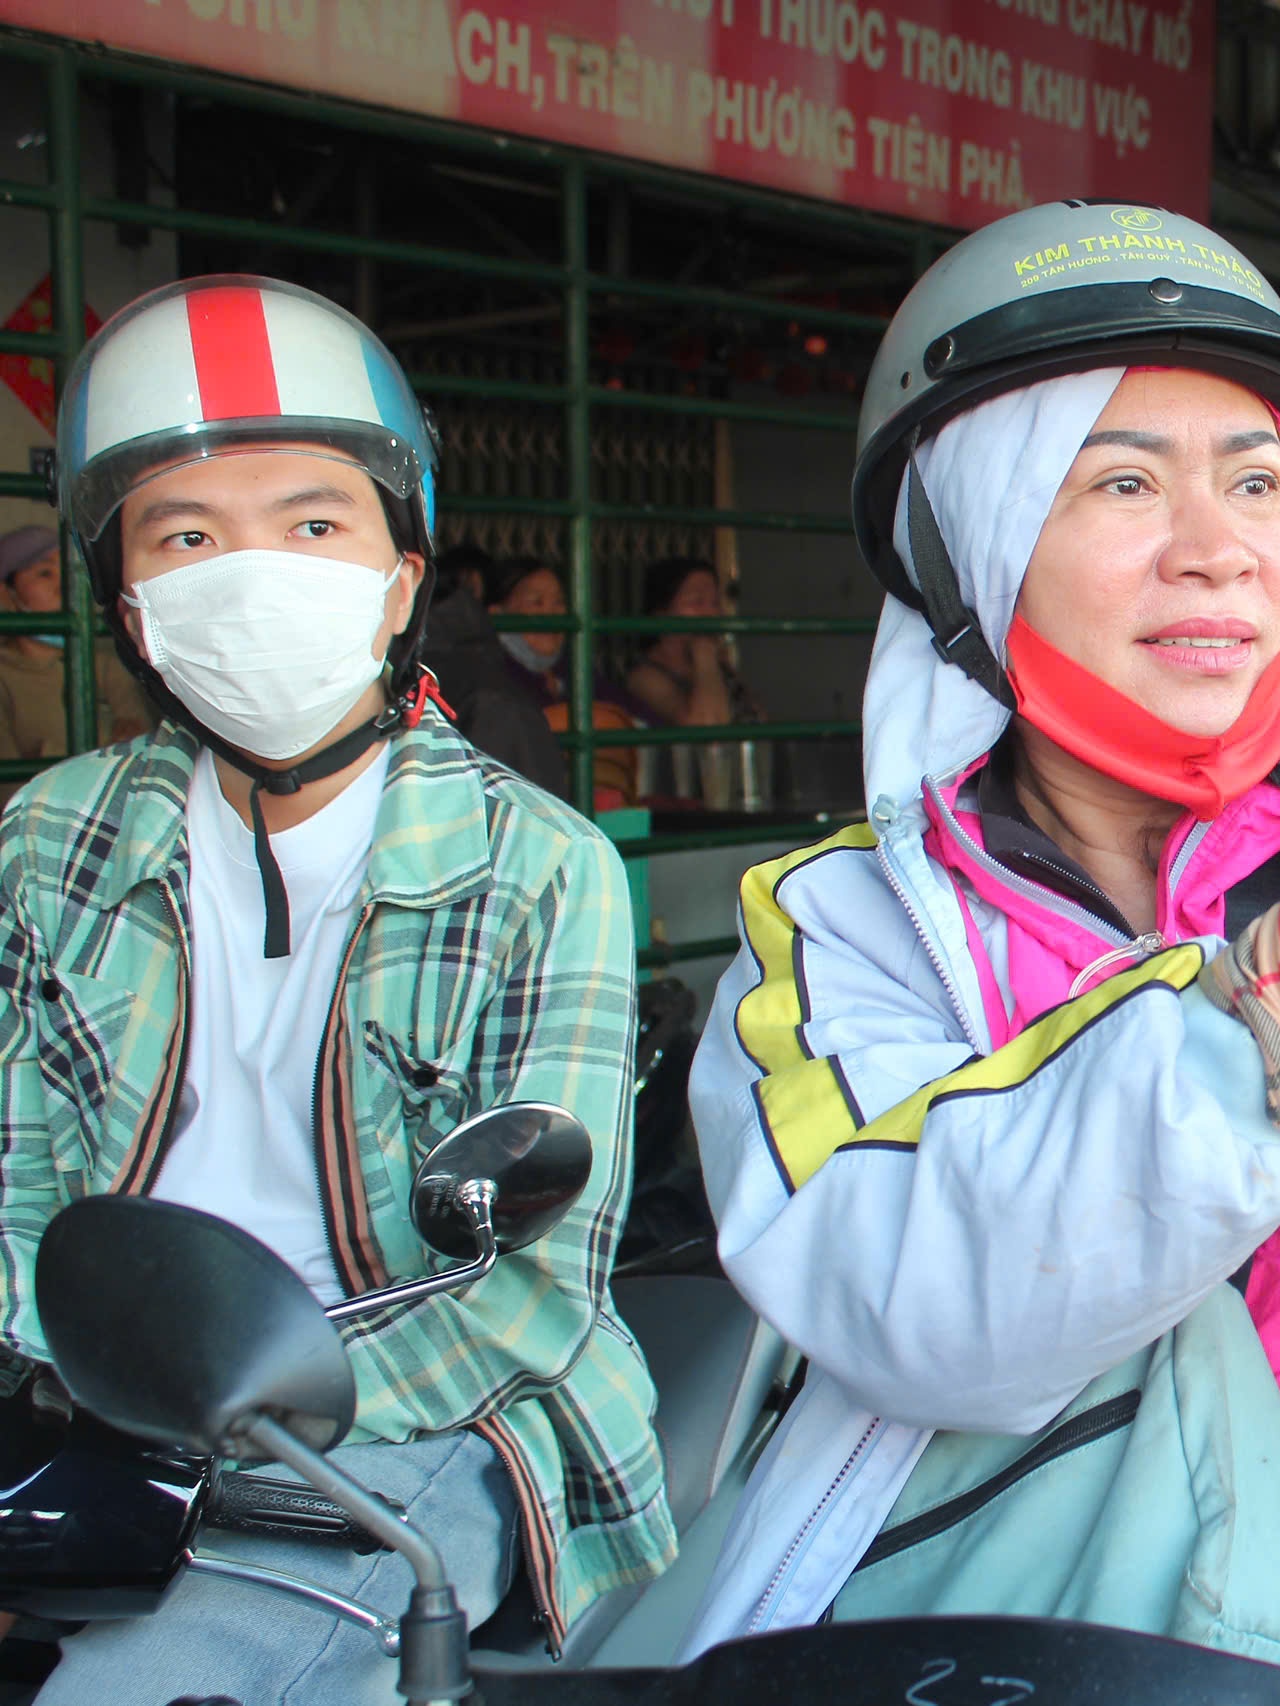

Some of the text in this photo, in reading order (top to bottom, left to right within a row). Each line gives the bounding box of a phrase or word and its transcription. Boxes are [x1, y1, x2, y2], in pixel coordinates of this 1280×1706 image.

[690, 67, 856, 170] PHƯƠNG
[868, 115, 951, 205] TIỆN
[896, 18, 1012, 108] TRONG
[1021, 58, 1087, 132] KHU
[1092, 82, 1151, 160] VỰC
[1014, 243, 1071, 276] KIM
[1077, 230, 1186, 253] THÀNH
